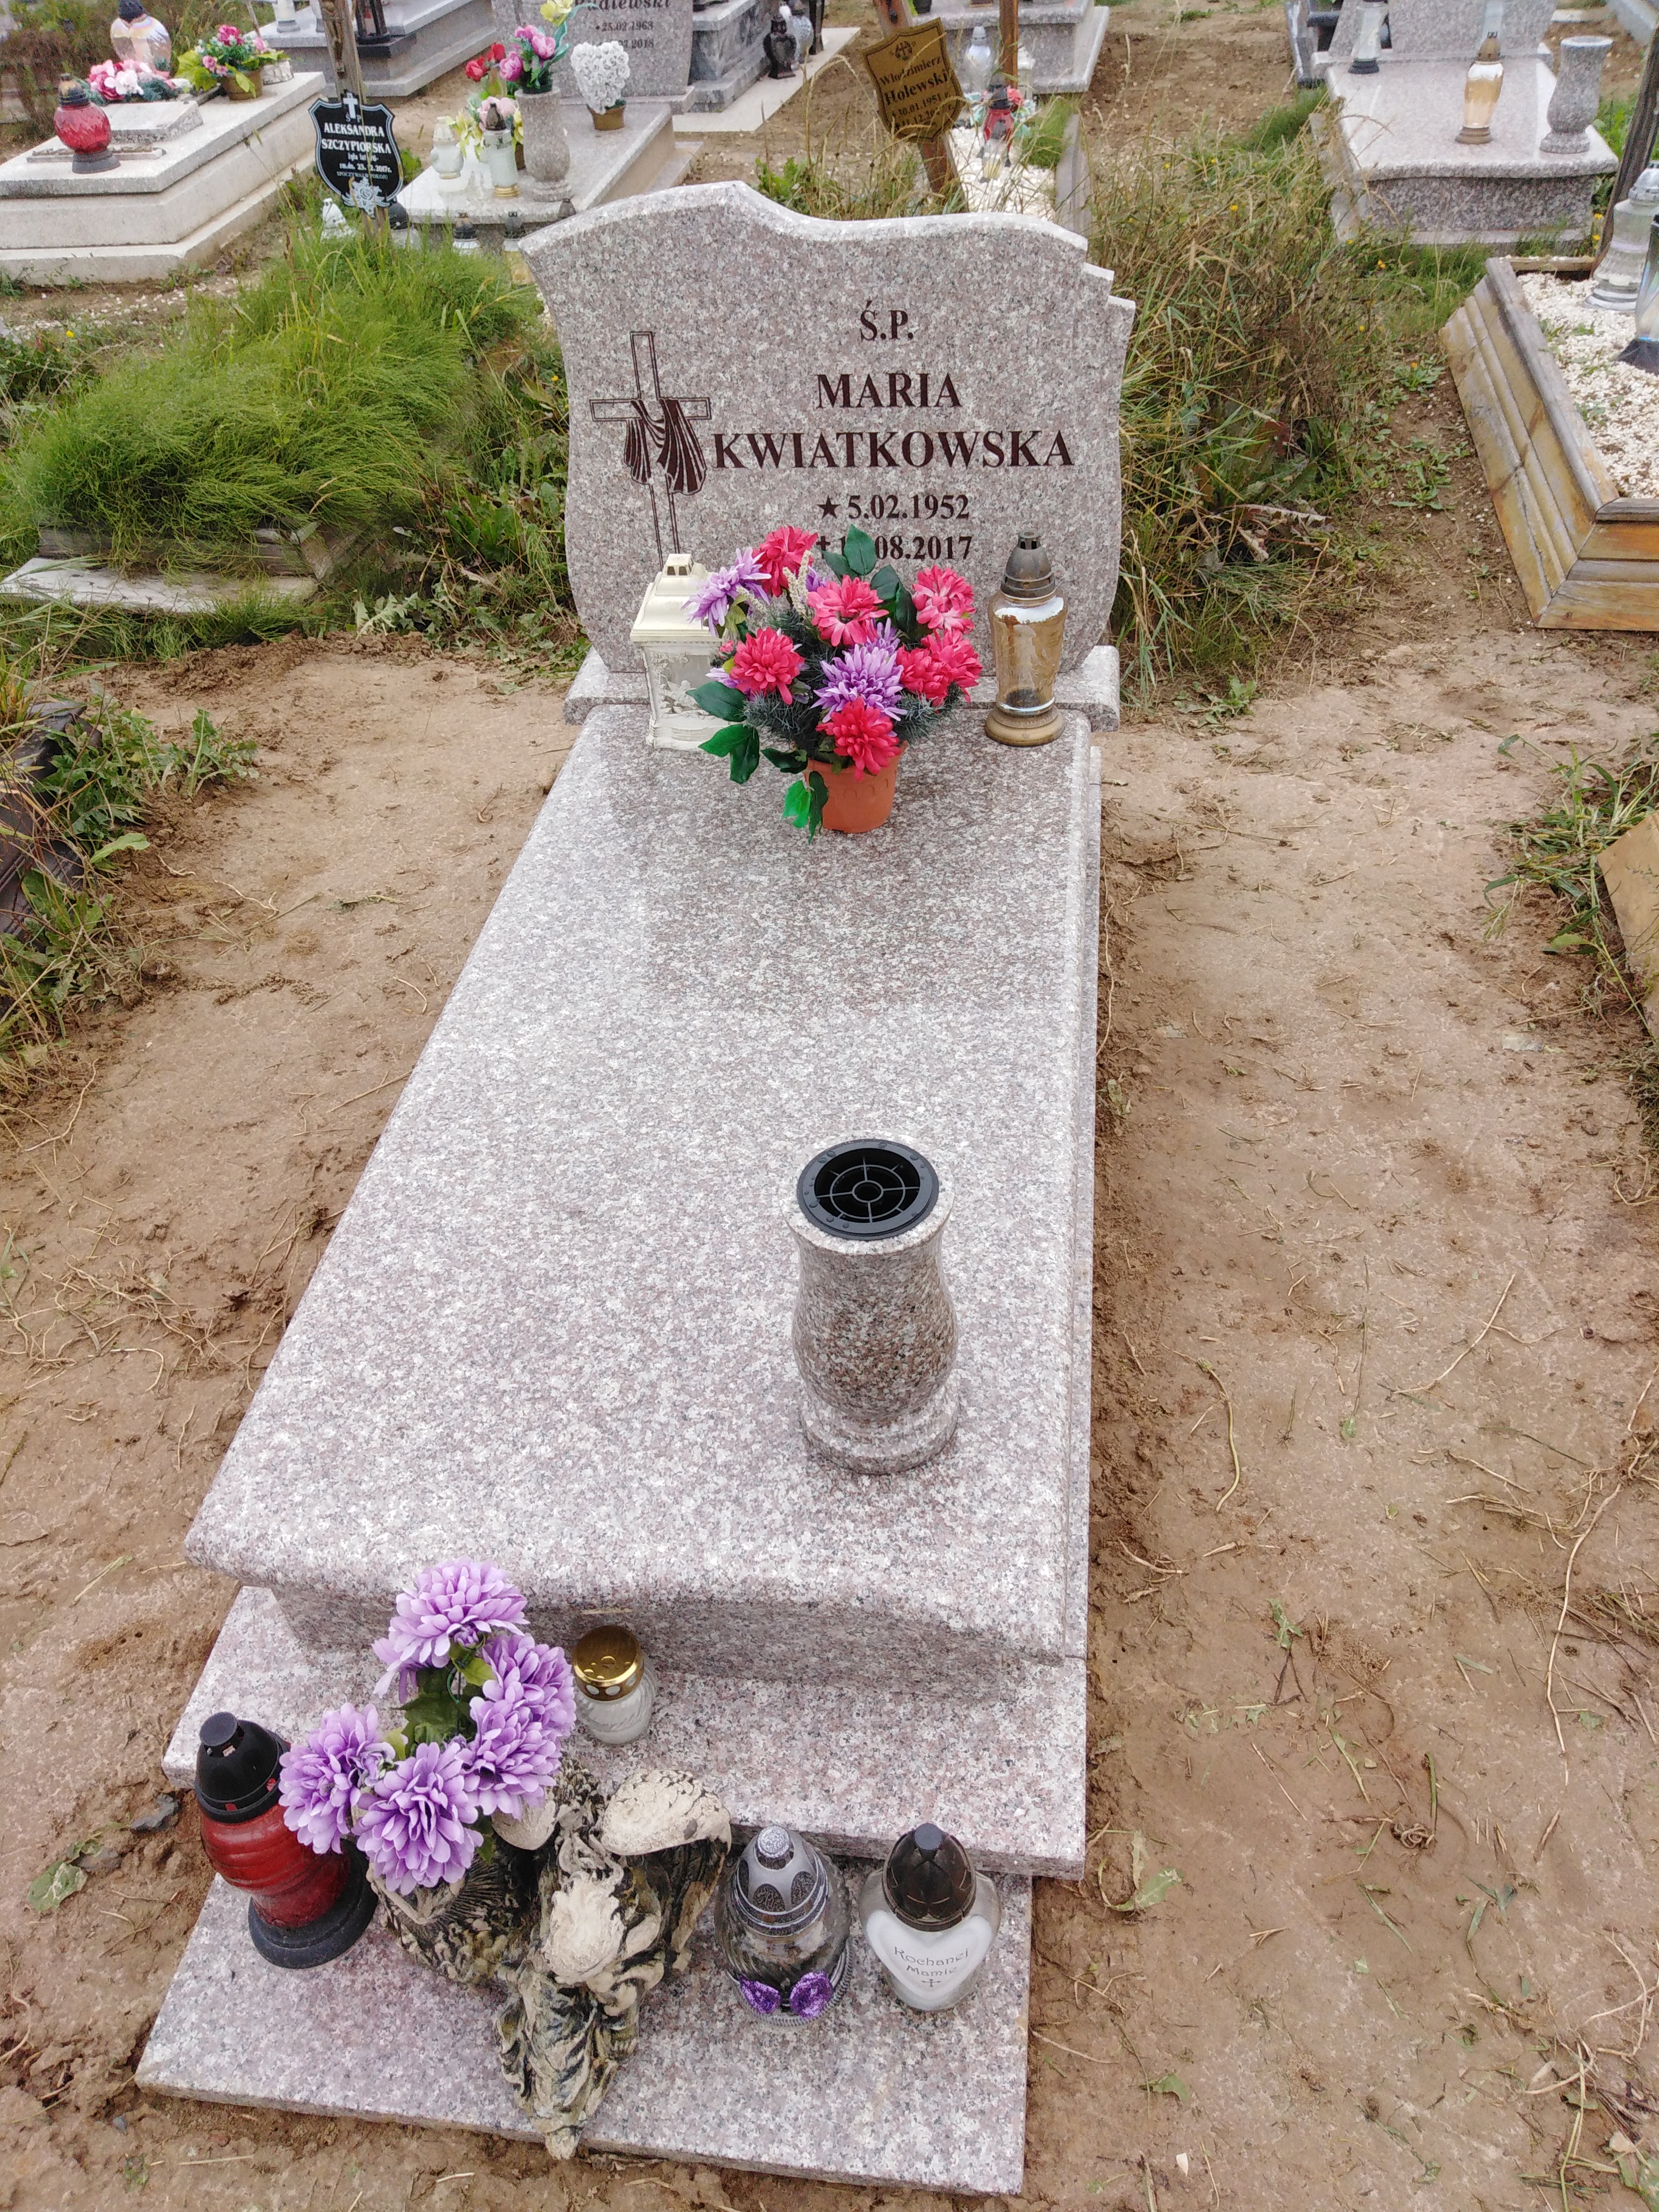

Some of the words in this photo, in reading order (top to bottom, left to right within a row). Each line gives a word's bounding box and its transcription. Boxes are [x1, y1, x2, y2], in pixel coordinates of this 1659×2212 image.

[884, 69, 949, 106] Holewski
[324, 122, 385, 137] ALEKSANDRA
[322, 139, 391, 154] SZCZYPIORSKA
[859, 300, 914, 342] Ś.P.
[816, 372, 963, 409] MARIA
[711, 430, 1075, 469] KWIATKOWSKA
[848, 495, 970, 520] 5.02.1952
[894, 1946, 968, 1966] Kochanej
[906, 1965, 957, 1976] Mamie
